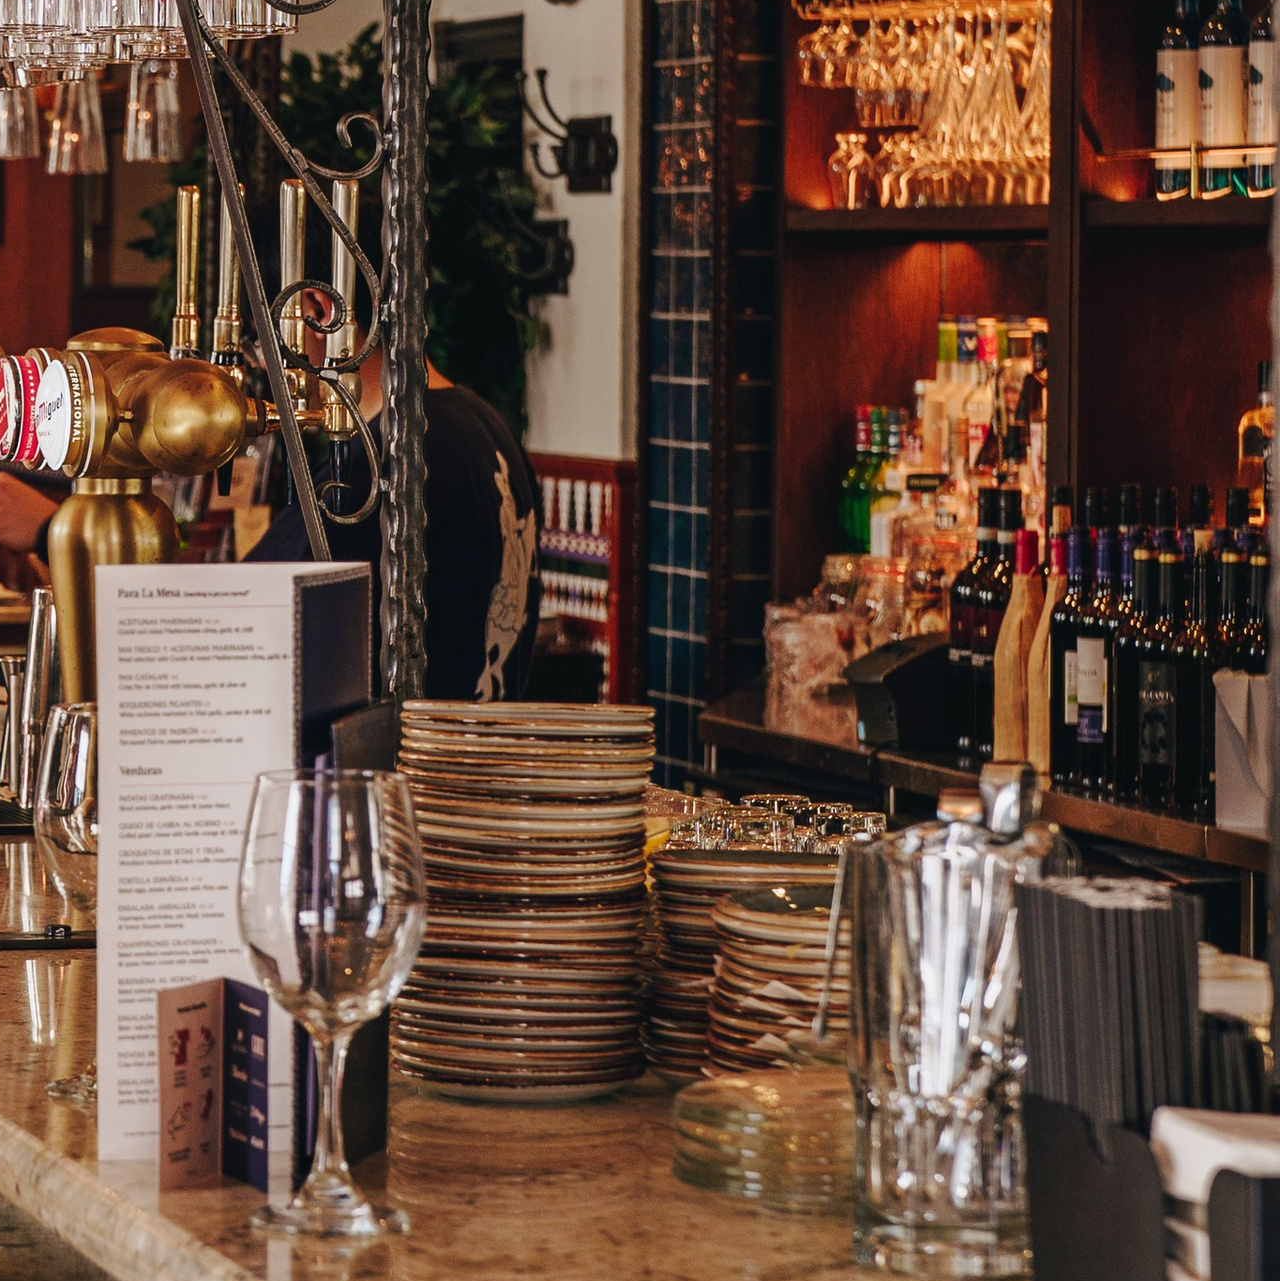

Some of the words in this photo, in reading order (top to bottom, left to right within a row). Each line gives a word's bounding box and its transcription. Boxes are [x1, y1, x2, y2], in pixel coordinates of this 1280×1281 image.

[117, 588, 139, 598] Para
[141, 588, 153, 597] La
[156, 588, 180, 597] Mesa
[119, 766, 162, 775] Verduras
